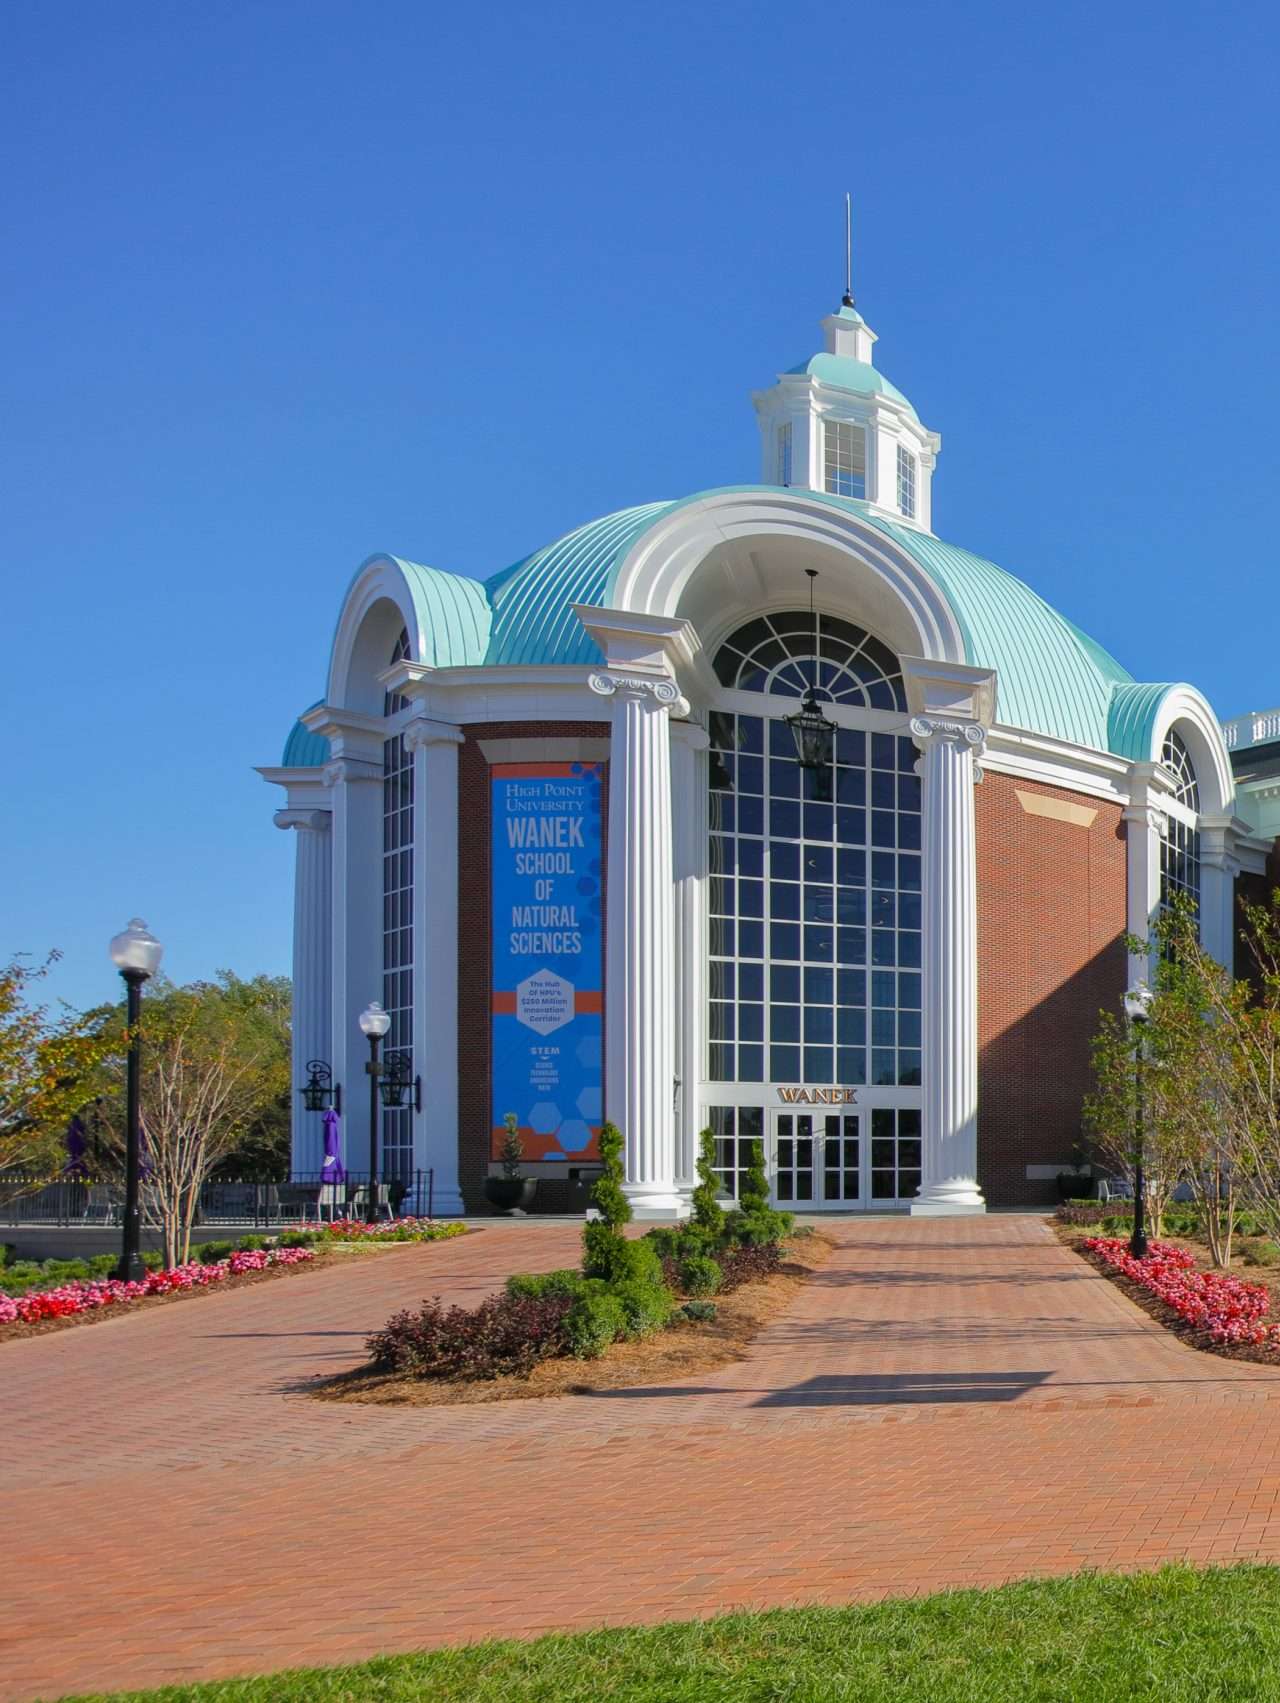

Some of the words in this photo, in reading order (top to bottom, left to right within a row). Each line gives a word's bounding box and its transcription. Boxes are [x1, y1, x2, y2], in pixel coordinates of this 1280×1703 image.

[506, 784, 540, 797] HIGH
[544, 783, 585, 796] POINT
[506, 798, 585, 811] UNIVERSITY
[506, 817, 585, 848] WANEK
[515, 852, 575, 875] SCHOOL
[535, 879, 555, 901] OF
[512, 906, 580, 927] NATURAL
[510, 932, 582, 955] SCIENCES
[530, 1047, 560, 1055] STEM
[777, 1087, 858, 1104] WANEK
